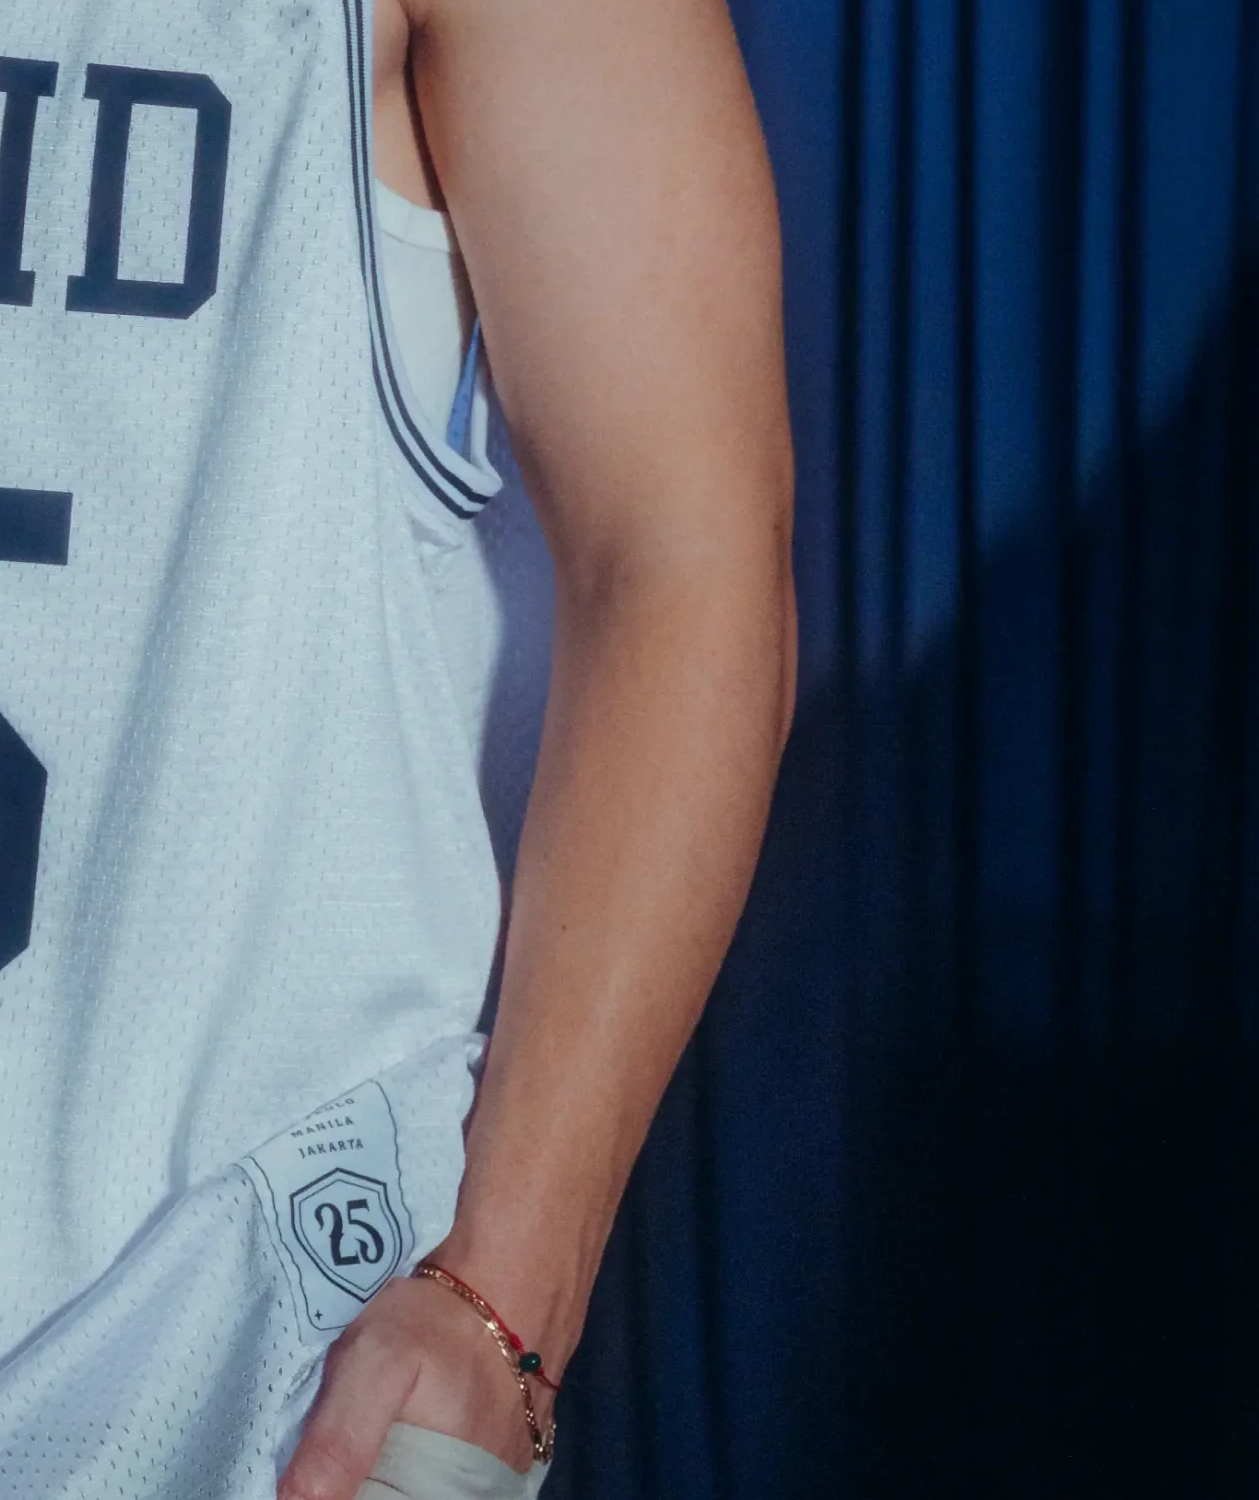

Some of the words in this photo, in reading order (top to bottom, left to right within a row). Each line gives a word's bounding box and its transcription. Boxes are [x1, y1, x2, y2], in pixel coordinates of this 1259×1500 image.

[290, 1116, 354, 1138] MANILA
[298, 1138, 364, 1159] JAKARTA
[314, 1198, 384, 1266] 25
